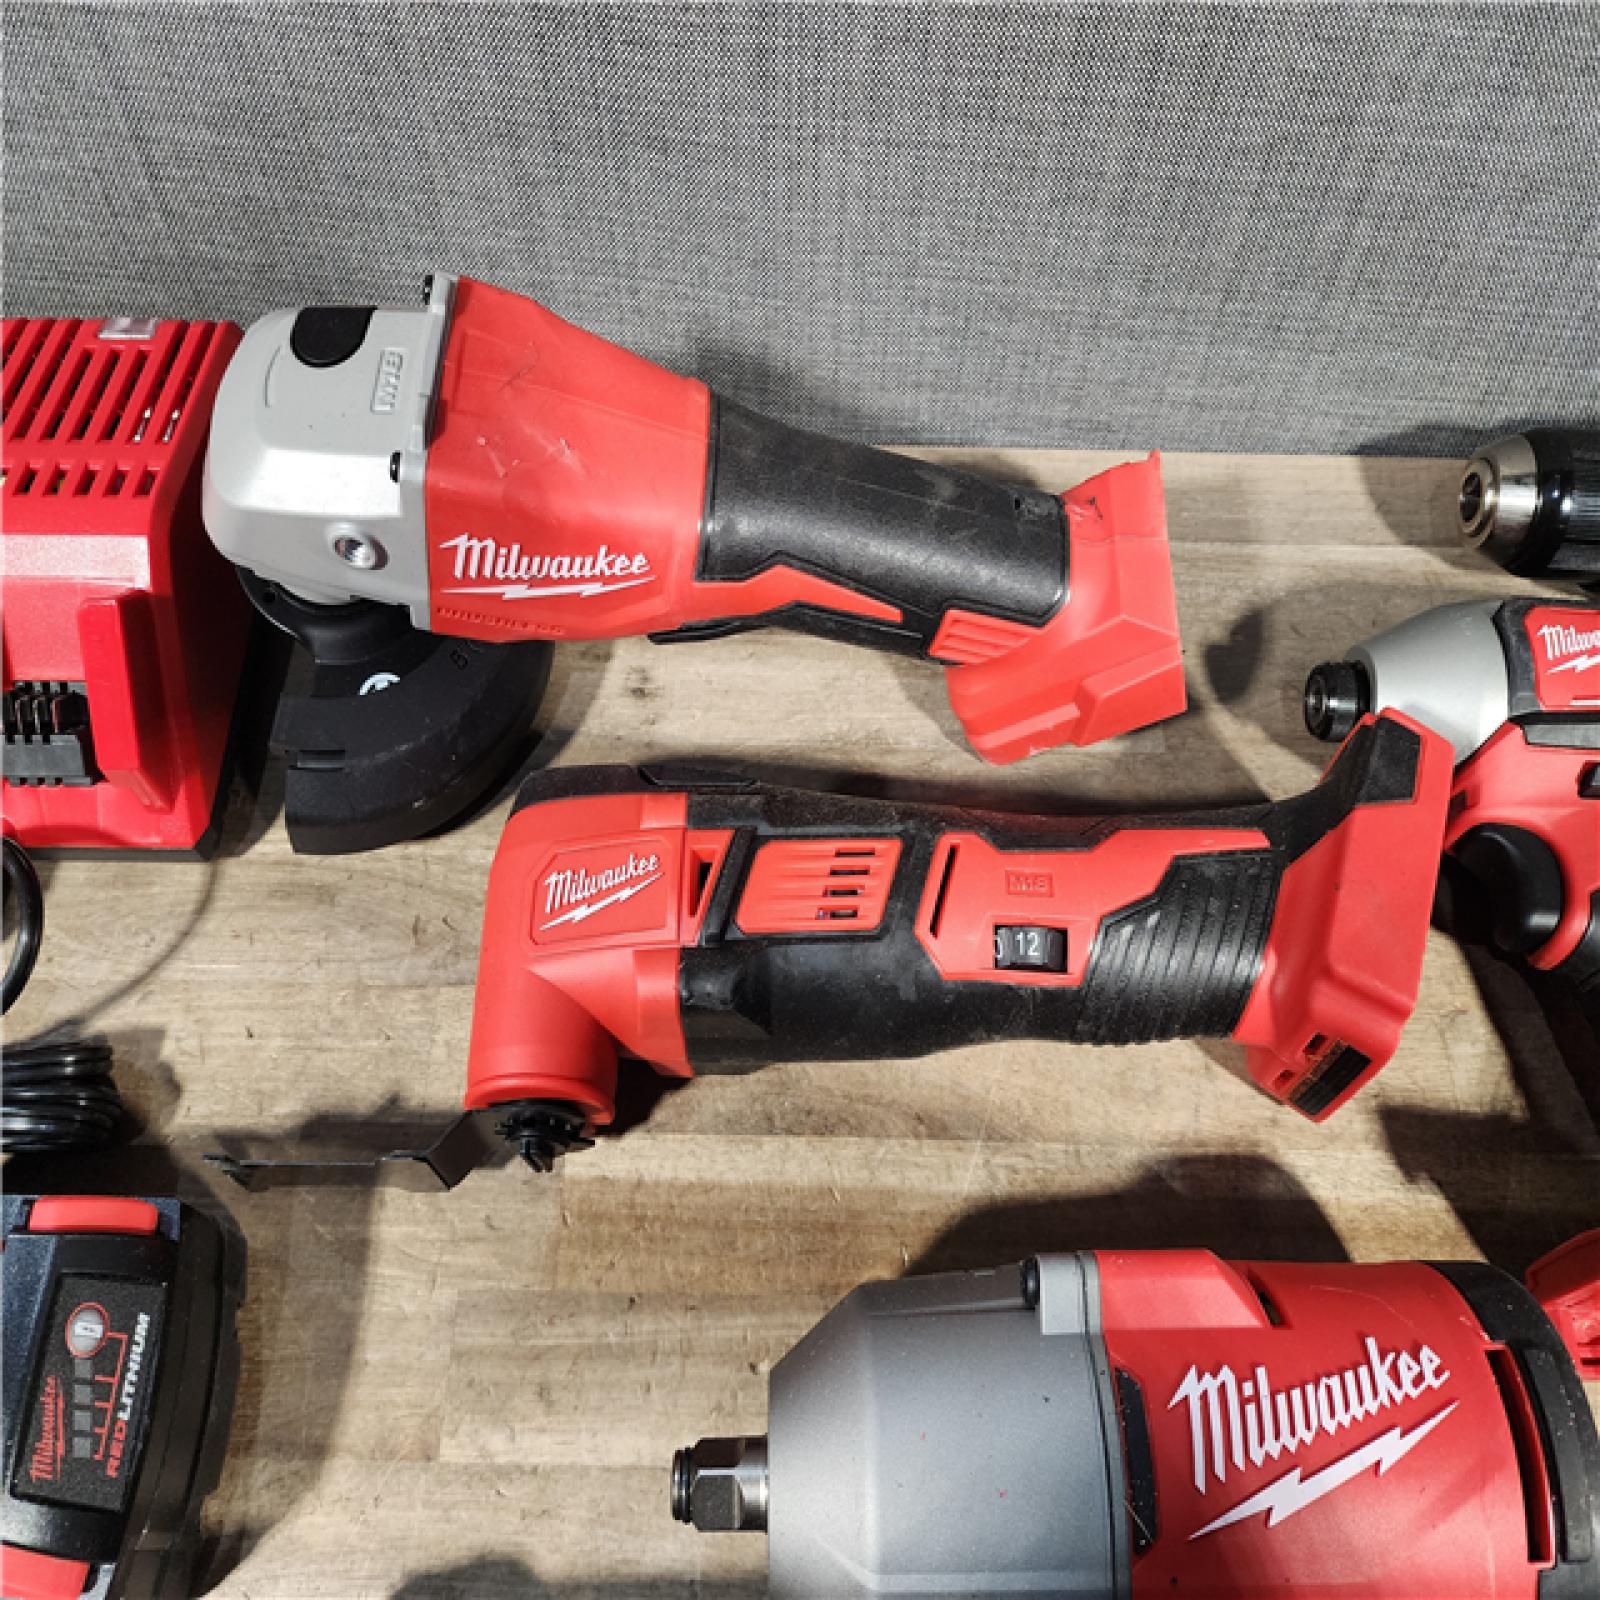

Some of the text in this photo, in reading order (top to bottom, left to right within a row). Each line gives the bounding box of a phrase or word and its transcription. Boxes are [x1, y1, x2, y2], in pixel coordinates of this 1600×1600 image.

[440, 533, 650, 580] Milwaukee
[545, 852, 659, 914] Milwaukee
[1015, 932, 1040, 956] 12
[30, 1376, 56, 1482] Milwaukee
[1167, 1336, 1450, 1495] Milwaukee
